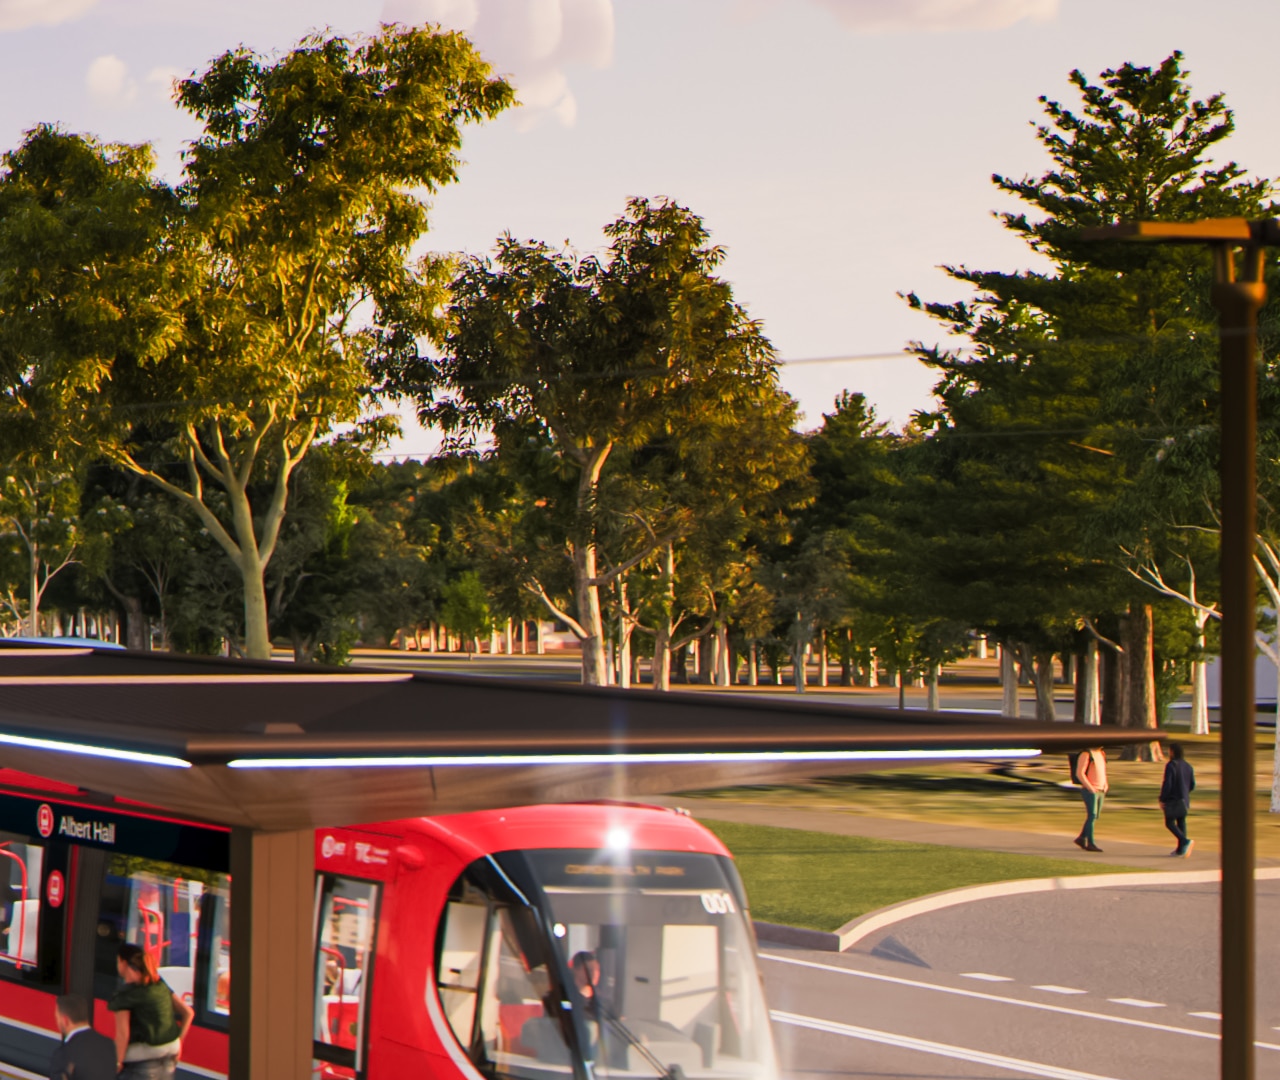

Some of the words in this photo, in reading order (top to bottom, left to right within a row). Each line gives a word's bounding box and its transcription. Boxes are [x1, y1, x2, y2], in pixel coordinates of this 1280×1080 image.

[58, 816, 92, 840] Albert
[93, 821, 116, 844] Hall
[700, 893, 737, 914] 001
